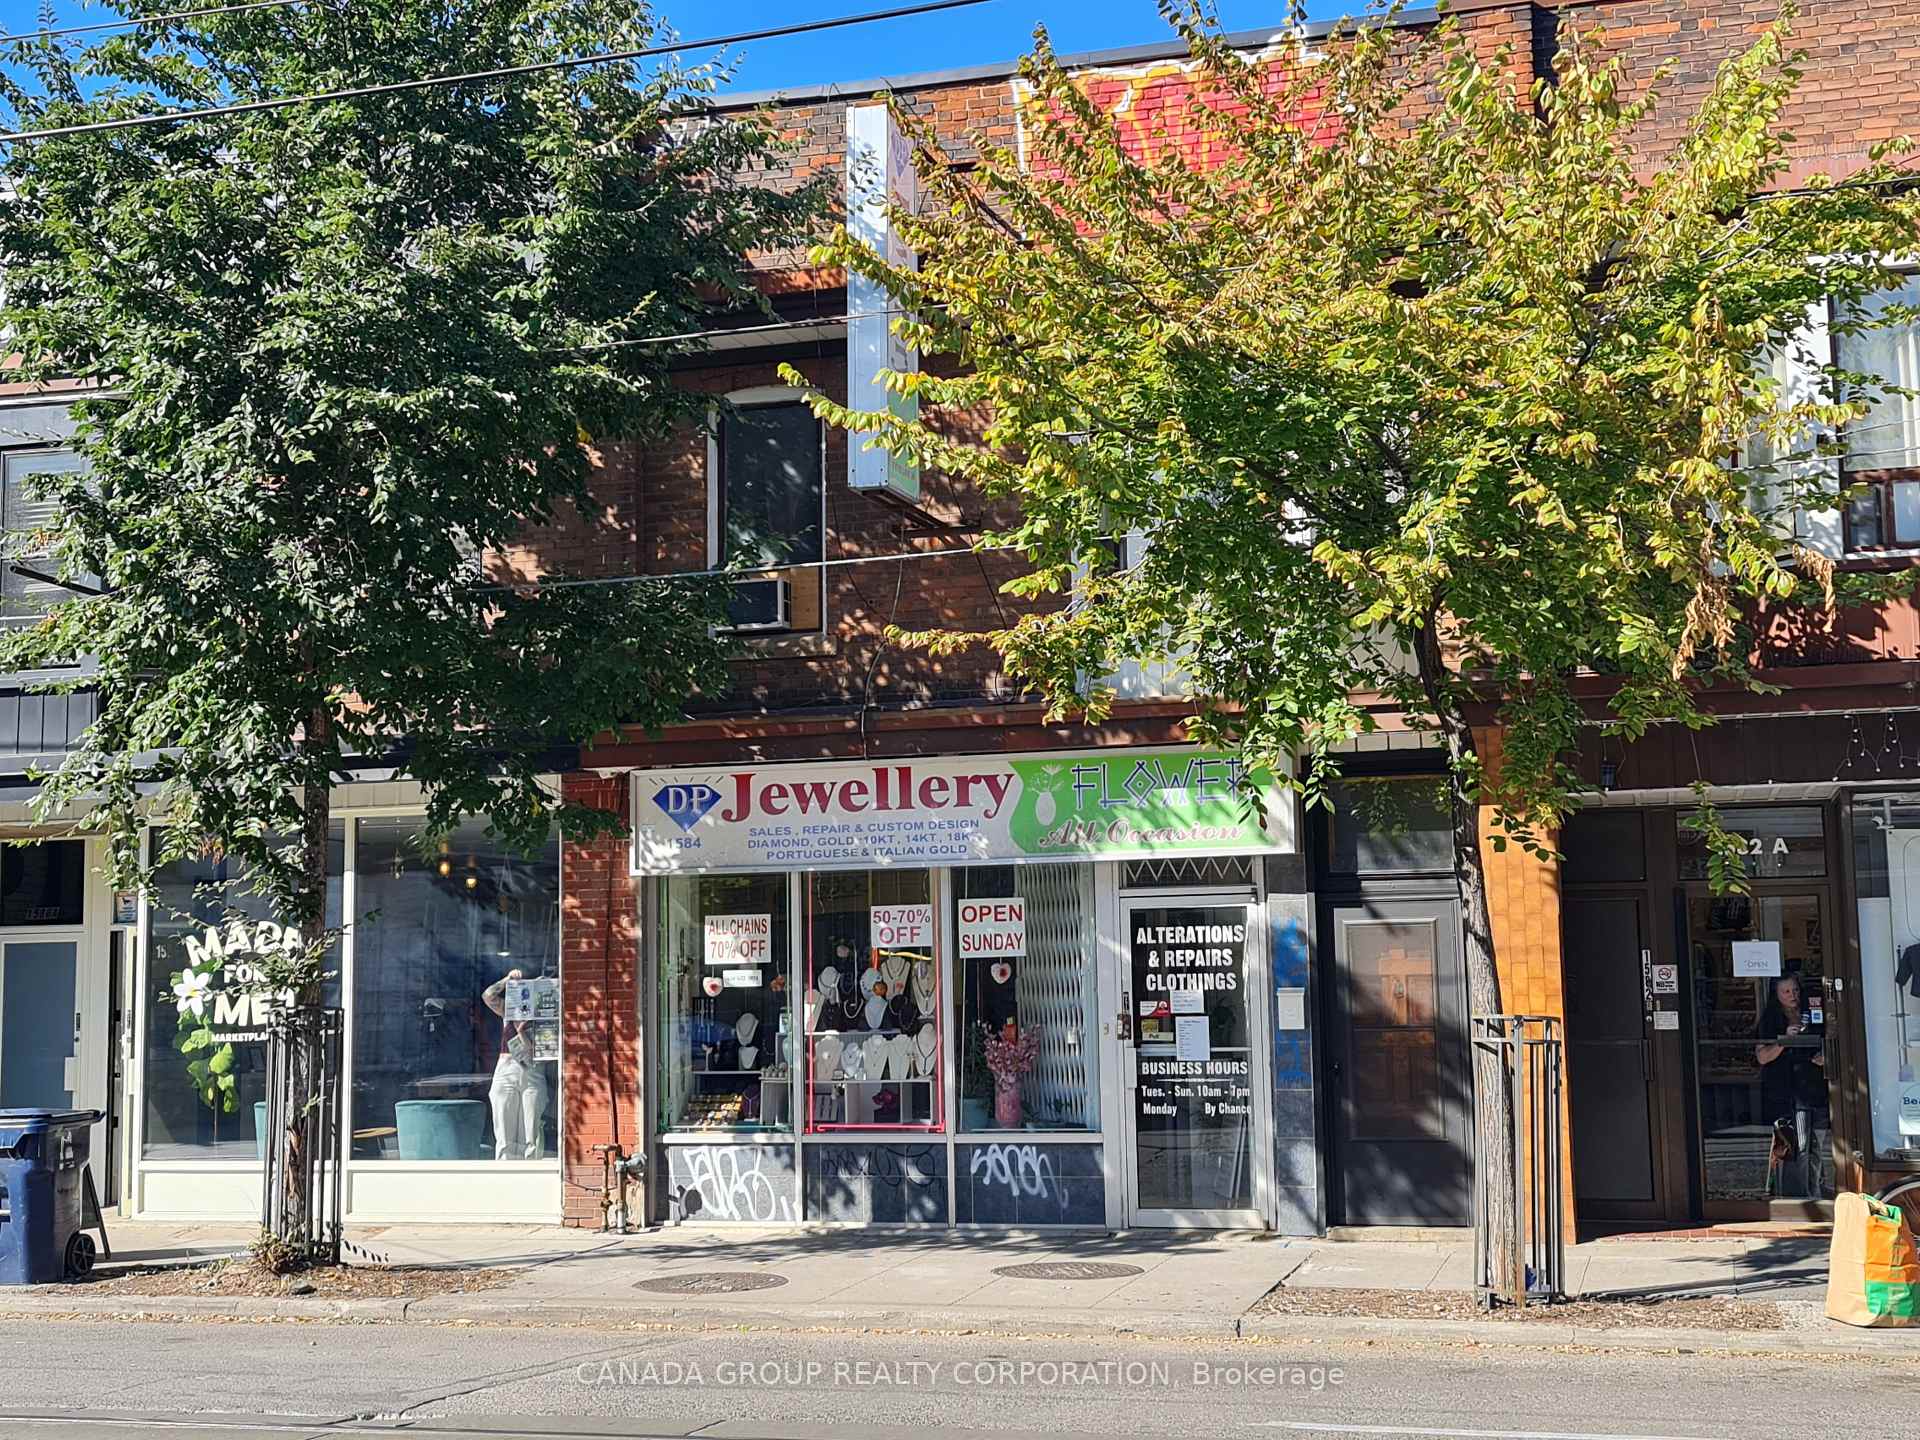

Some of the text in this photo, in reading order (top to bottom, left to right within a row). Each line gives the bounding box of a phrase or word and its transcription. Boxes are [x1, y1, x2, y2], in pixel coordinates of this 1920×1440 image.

[668, 786, 712, 814] DP
[721, 767, 1015, 822] Jewellery
[803, 823, 849, 835] REPAIR
[856, 823, 863, 833] &
[868, 820, 923, 832] CUSTOM
[928, 819, 980, 830] DESIGN
[1106, 818, 1241, 845] Occasion
[766, 844, 967, 861] PORTUGUESE & ITALIAN GOLD
[873, 908, 931, 923] 50-70%
[962, 904, 1023, 923] OPEN
[708, 918, 767, 935] ALL CHAINS
[879, 926, 921, 944] OFF
[1136, 925, 1244, 945] ALTERATIONS
[710, 940, 766, 958] 70% OFF
[962, 932, 1023, 952] SUNDAY
[1148, 949, 1233, 967] & REPAIRS
[1145, 973, 1237, 991] CLOTHINGS
[211, 1032, 269, 1042] MARKETPLA
[1141, 1061, 1248, 1075] BUSINESS HOURS
[1141, 1085, 1165, 1097] Tues.
[1174, 1085, 1194, 1097] Sun.
[1197, 1085, 1221, 1097] 10am
[1143, 1103, 1177, 1116] Monday
[1205, 1103, 1216, 1117] By
